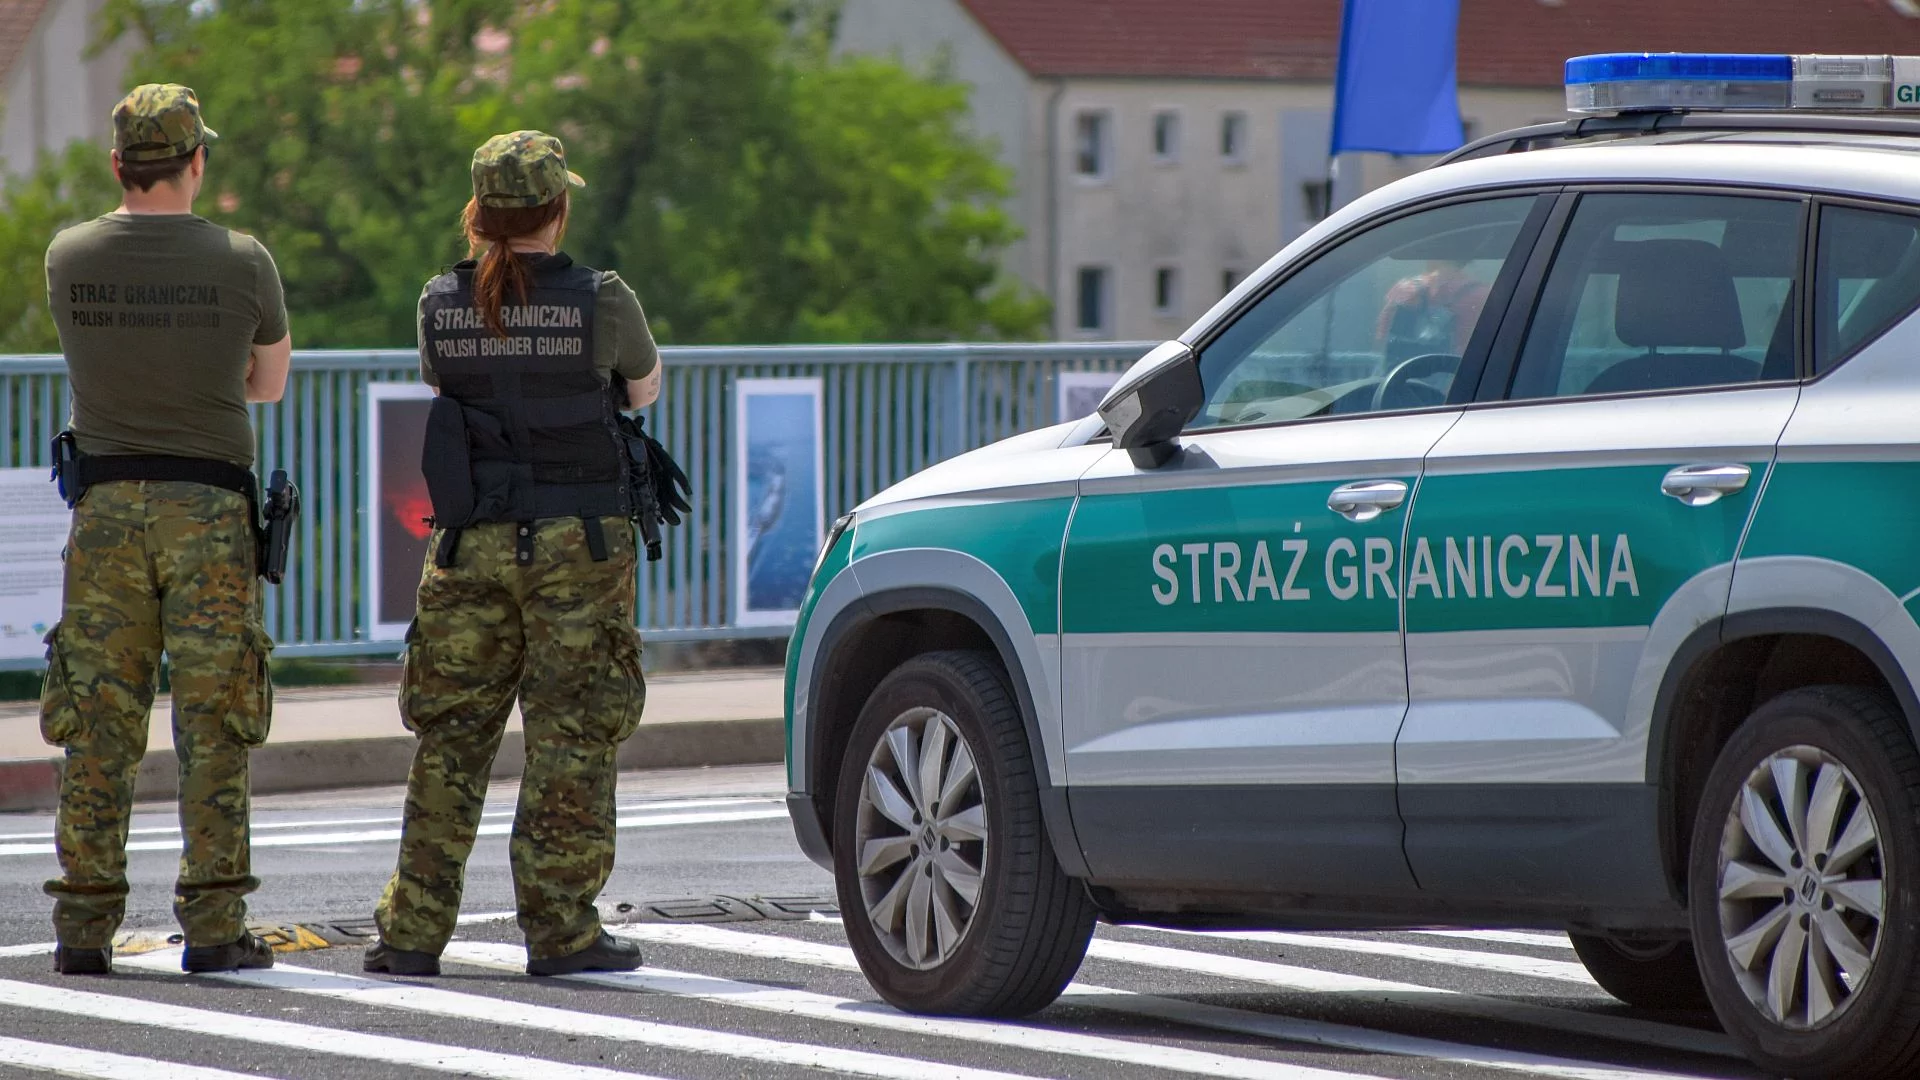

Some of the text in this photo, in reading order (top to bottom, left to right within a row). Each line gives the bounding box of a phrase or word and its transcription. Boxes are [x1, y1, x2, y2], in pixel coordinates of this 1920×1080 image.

[124, 284, 219, 305] GRANICZNA
[72, 310, 112, 327] POLISH
[119, 312, 171, 328] BORDER
[490, 306, 582, 328] RANICZNA
[435, 336, 582, 358] POLISH BORDER GUARD
[1152, 522, 1639, 605] STRAŻ GRANICZNA
